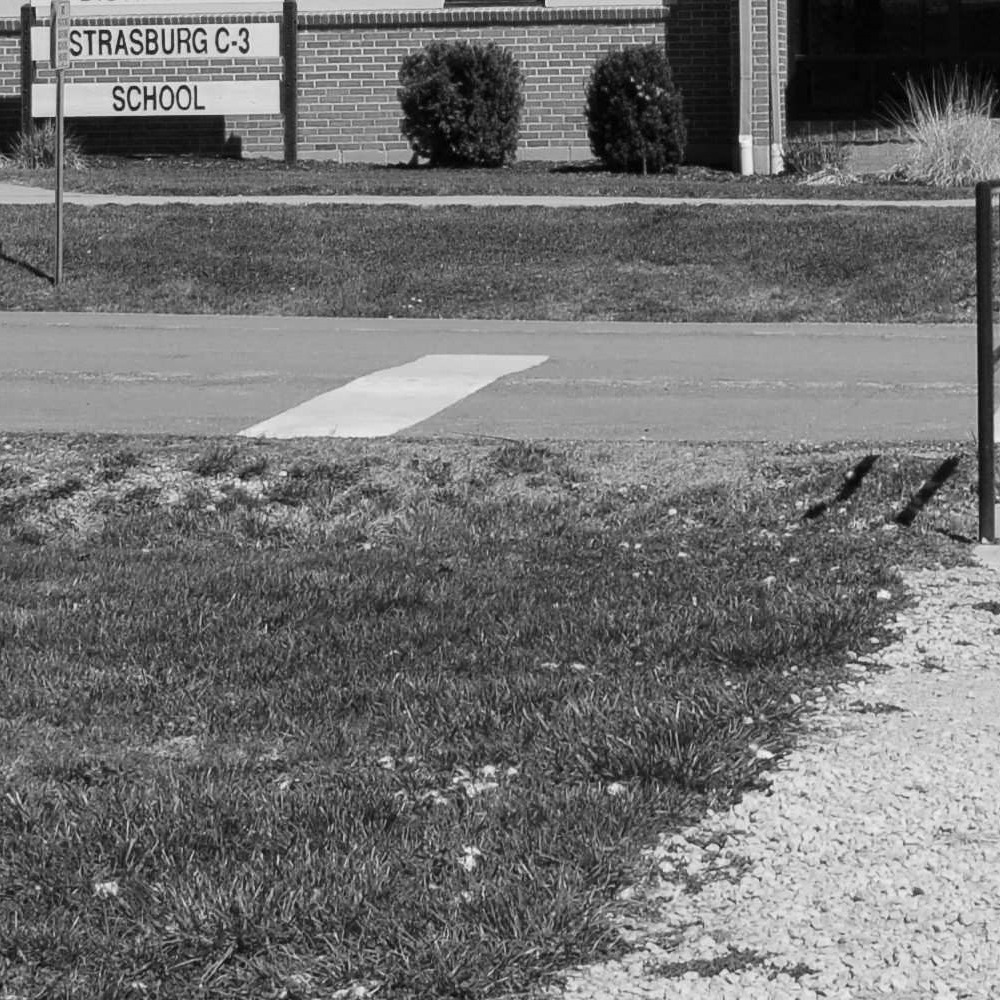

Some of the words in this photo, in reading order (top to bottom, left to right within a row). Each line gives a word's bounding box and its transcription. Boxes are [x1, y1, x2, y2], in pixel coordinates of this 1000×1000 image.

[69, 27, 208, 57] STRASBURG
[215, 27, 250, 54] C-3
[112, 85, 206, 112] SCHOOL
